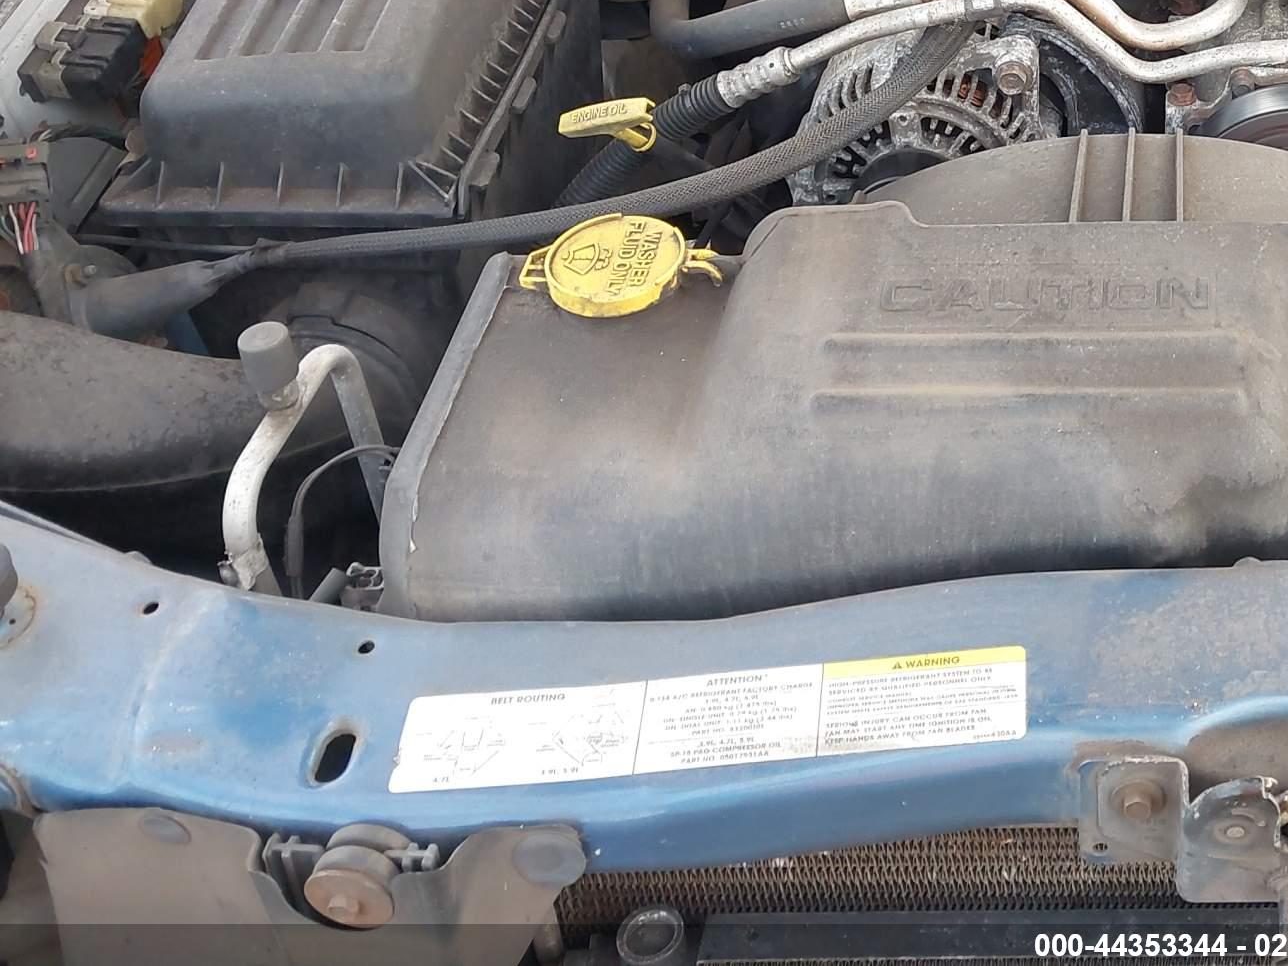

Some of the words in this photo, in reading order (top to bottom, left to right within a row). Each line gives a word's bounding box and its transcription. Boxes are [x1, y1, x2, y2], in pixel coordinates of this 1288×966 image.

[571, 106, 608, 123] ENGINE
[608, 103, 627, 115] OIL
[629, 231, 663, 288] WASHER
[606, 260, 632, 296] ONLY
[879, 277, 1210, 312] CAUTION
[905, 656, 960, 669] WARNING
[706, 674, 763, 687] ATTENTION
[490, 695, 513, 706] BELT
[516, 691, 566, 704] ROUTING
